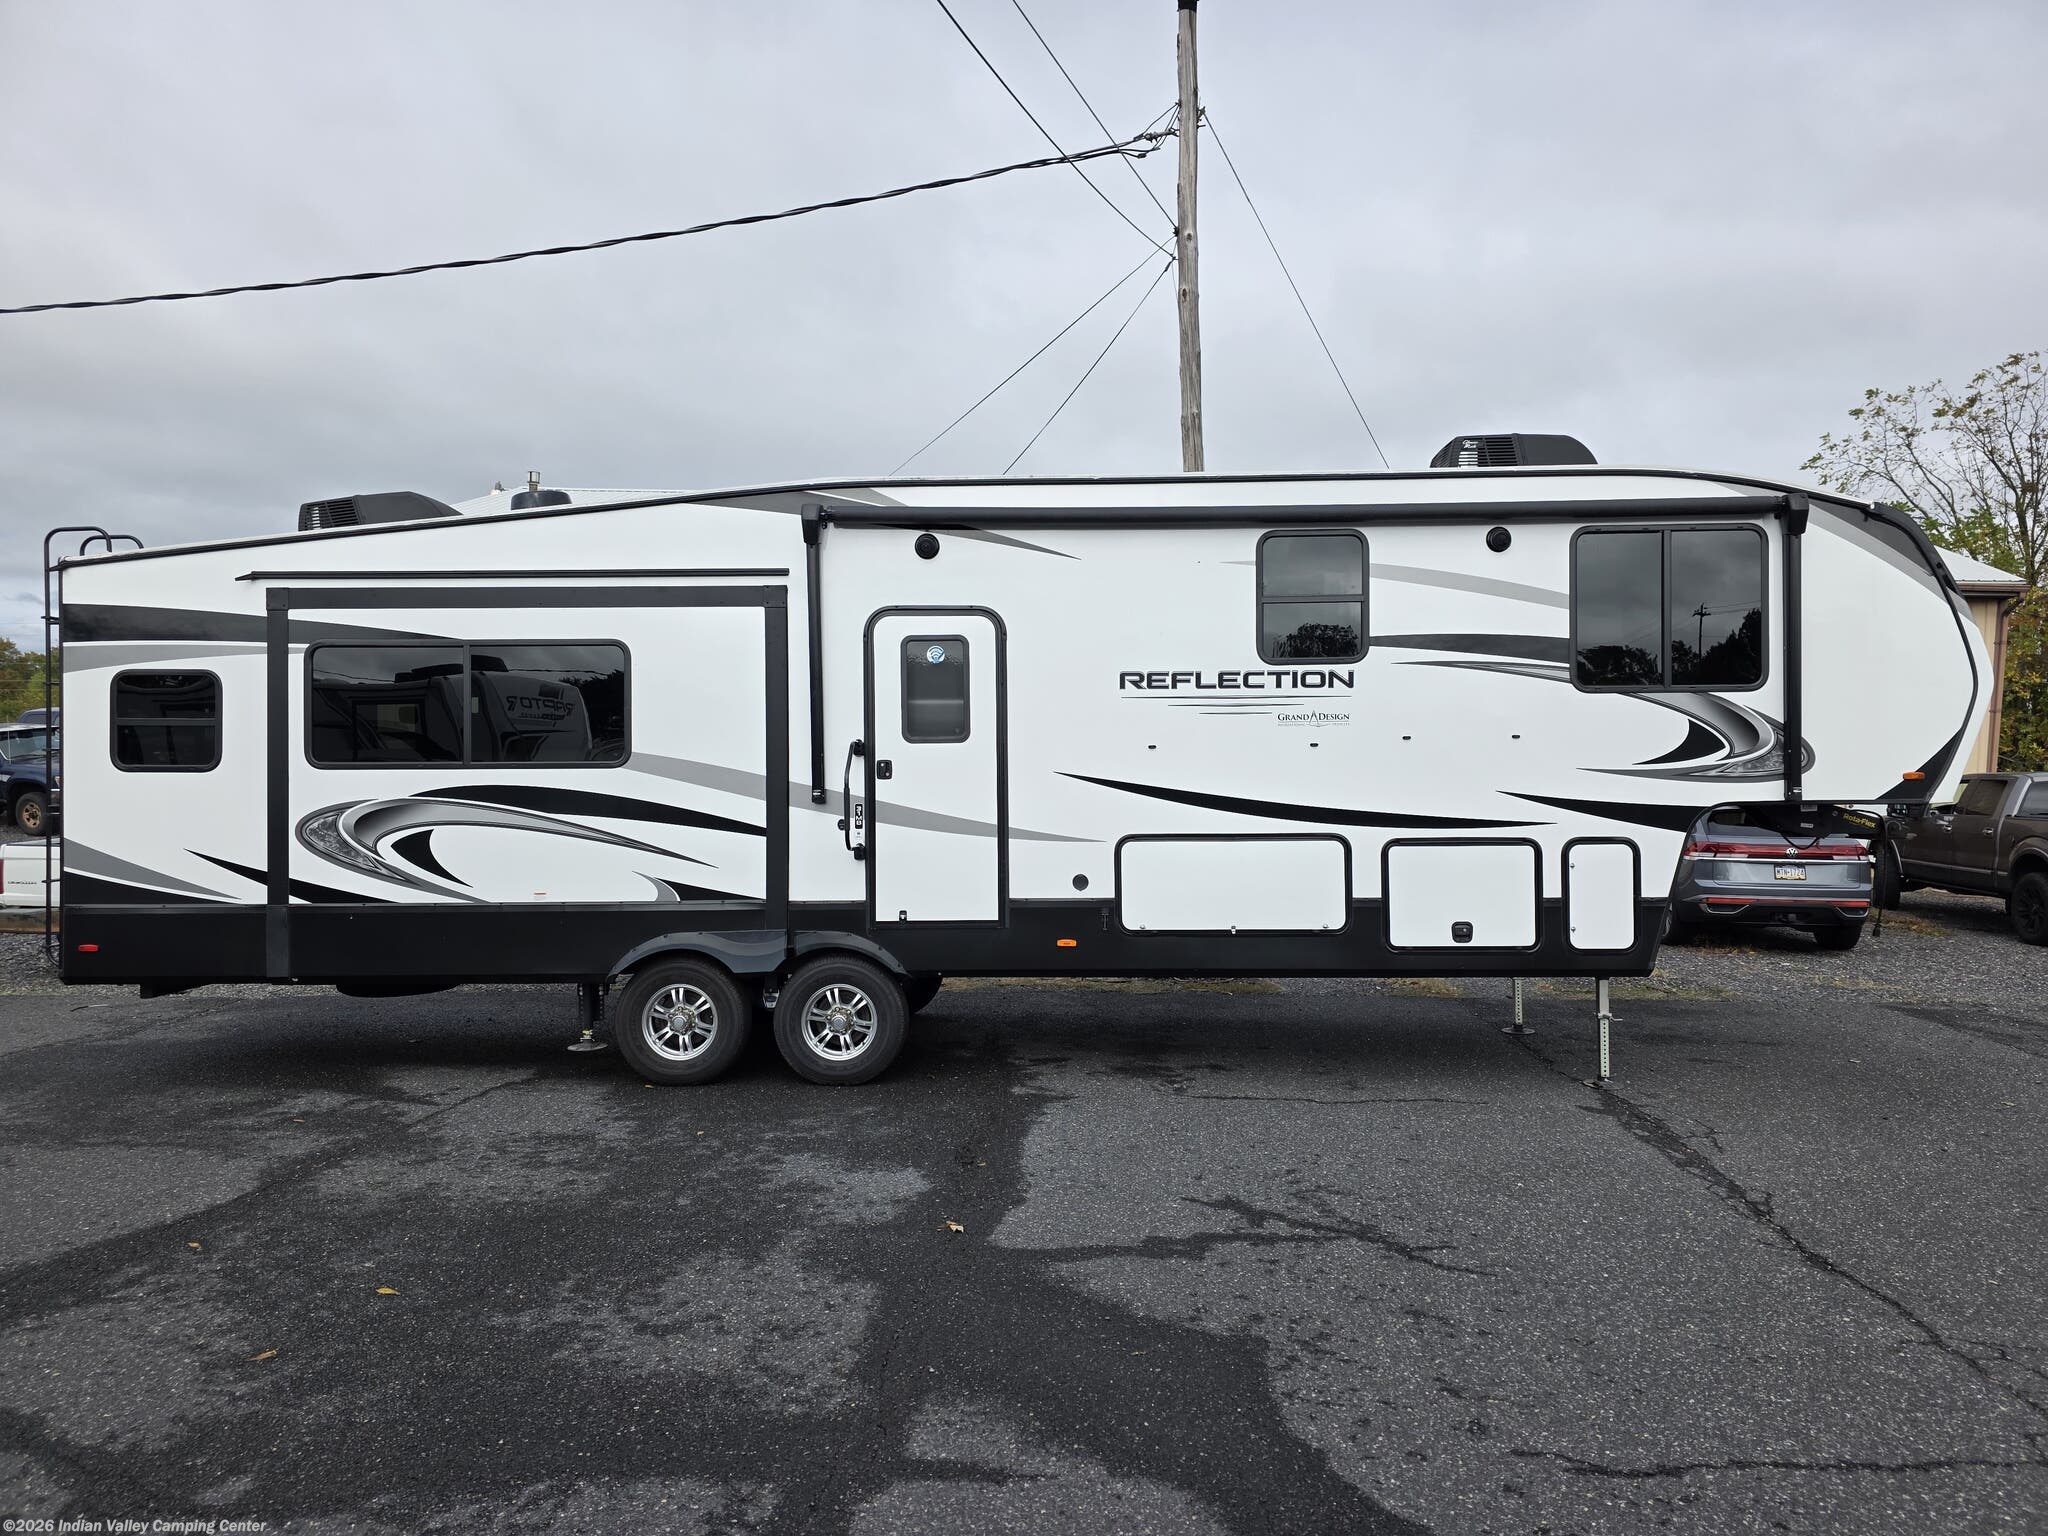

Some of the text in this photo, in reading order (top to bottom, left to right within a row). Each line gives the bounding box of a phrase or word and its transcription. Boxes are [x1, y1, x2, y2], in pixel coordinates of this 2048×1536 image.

[1119, 669, 1355, 690] REFLECTION
[1318, 712, 1350, 721] DESIGN
[1843, 812, 1877, 829] Rota-Flex
